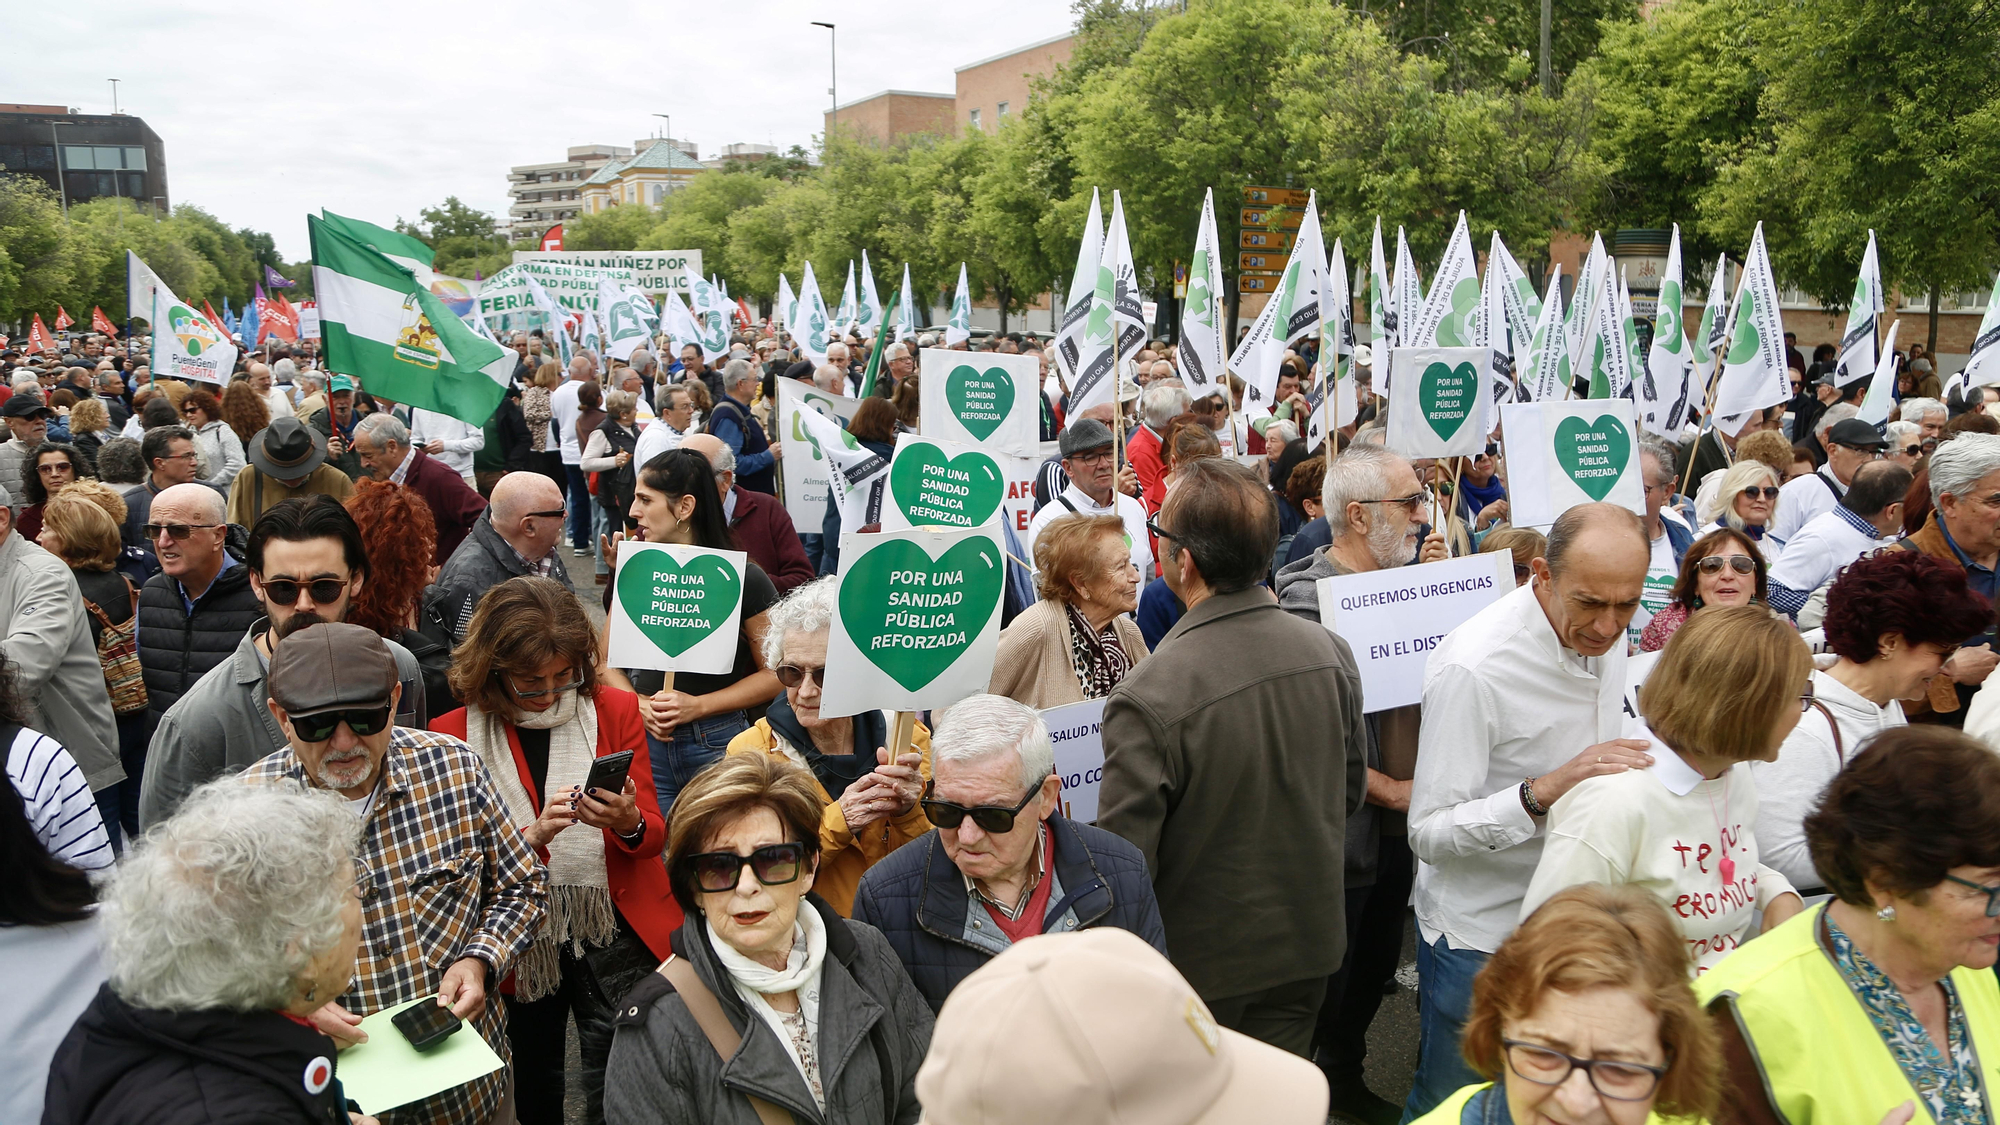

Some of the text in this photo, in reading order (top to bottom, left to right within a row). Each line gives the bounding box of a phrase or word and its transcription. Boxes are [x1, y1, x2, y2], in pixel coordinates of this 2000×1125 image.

[555, 267, 571, 276] EN
[1761, 278, 1767, 287] EN
[1509, 282, 1520, 306] DEFENSA
[1518, 307, 1523, 315] DE
[1763, 287, 1774, 318] DEFENSA
[1612, 319, 1618, 329] EN
[1750, 268, 1773, 369] AGUILAR DE LA FRONTERA
[1770, 319, 1776, 328] DE
[1511, 312, 1526, 347] FRONTERA
[1601, 309, 1610, 347] AGUILAR
[1772, 329, 1777, 338] LA
[1605, 349, 1612, 360] DE
[1614, 331, 1622, 366] DEFENSA
[1774, 339, 1782, 366] SANIDAD
[181, 365, 217, 380] HOSPITAL
[1608, 361, 1614, 373] LA
[966, 391, 996, 399] SANIDAD
[1436, 389, 1463, 397] SANIDAD
[966, 400, 994, 410] PÚBLICA
[1435, 399, 1460, 408] PÚBLICA
[961, 412, 1001, 420] REFORZADA
[1430, 411, 1464, 420] REFORZADA
[1575, 432, 1607, 442] POR UNA
[1577, 445, 1609, 454] SANIDAD
[871, 459, 880, 467] UN
[1579, 456, 1609, 466] PÚBLICA
[922, 464, 970, 482] POR UNA
[1574, 468, 1618, 479] REFORZADA
[922, 478, 970, 496] SANIDAD
[920, 492, 964, 510] PÚBLICA
[909, 505, 972, 526] REFORZADA
[652, 572, 704, 585] POR UNA
[889, 570, 964, 586] POR UNA
[652, 587, 705, 599] SANIDAD
[888, 591, 962, 608] SANIDAD
[1341, 575, 1493, 611] QUEREMOS URGENCIAS
[651, 601, 700, 613] PÚBLICA
[641, 615, 711, 629] REFORZADA
[885, 610, 955, 628] PÚBLICA
[871, 631, 966, 650] REFORZADA
[1370, 643, 1390, 659] EN
[1394, 641, 1410, 655] EL
[1060, 773, 1081, 790] NO
